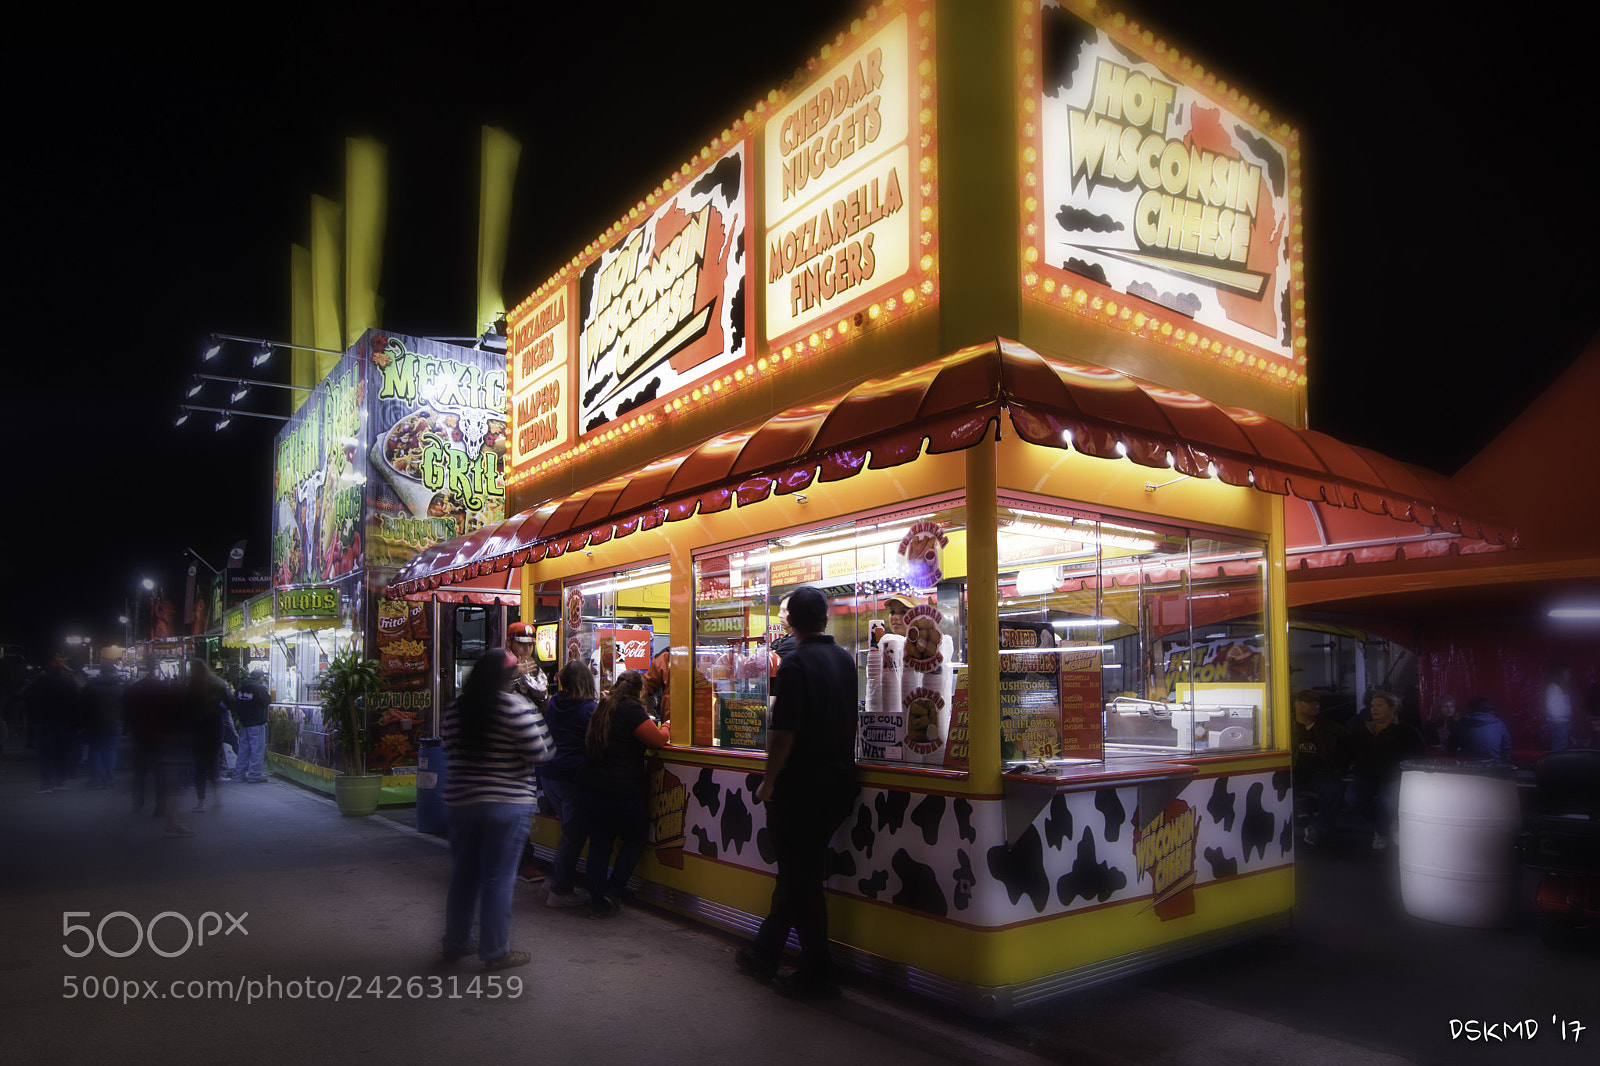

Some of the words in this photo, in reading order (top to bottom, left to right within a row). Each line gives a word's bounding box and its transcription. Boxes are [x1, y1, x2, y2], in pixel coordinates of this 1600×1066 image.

[780, 46, 884, 157] CHEDDAR
[1094, 57, 1176, 133] HOT
[782, 95, 882, 202] NUGGETS
[1067, 105, 1262, 216] WISCONSIN
[769, 166, 903, 284] MOZZARELLA
[1135, 190, 1251, 262] CHEESE
[596, 226, 646, 315] HOT
[791, 232, 876, 318] FINGERS
[586, 200, 711, 374] WISCONSIN
[514, 294, 566, 357] MOZZARELLA
[616, 263, 699, 375] CHEESE
[522, 332, 555, 379] FINGERS
[519, 411, 558, 456] CHEDDAR
[379, 511, 457, 547] BURRITOS
[277, 591, 337, 613] SALADS
[903, 604, 944, 626] CHEDDAR
[379, 613, 407, 630] Fritos
[623, 640, 649, 658] Cola
[1000, 628, 1038, 649] FRIED
[903, 652, 944, 674] NUGGETS
[998, 653, 1058, 673] GETABLES
[1170, 646, 1208, 672] HOT
[724, 717, 763, 727] CAULIFLOWER
[860, 715, 876, 728] ICE
[877, 715, 903, 728] COLD
[1000, 718, 1056, 730] AULIFLOWER
[1002, 706, 1046, 717] BROCCOLI
[726, 724, 761, 734] MUSHROOMS
[866, 729, 897, 742] BOTTLED
[1004, 731, 1047, 742] ZUCCHINI
[903, 735, 944, 756] CHEDDAR
[1039, 743, 1053, 759] $9
[655, 809, 684, 843] CHEESE
[1135, 805, 1197, 882] WISCONSIN
[1154, 840, 1193, 894] CHEESE
